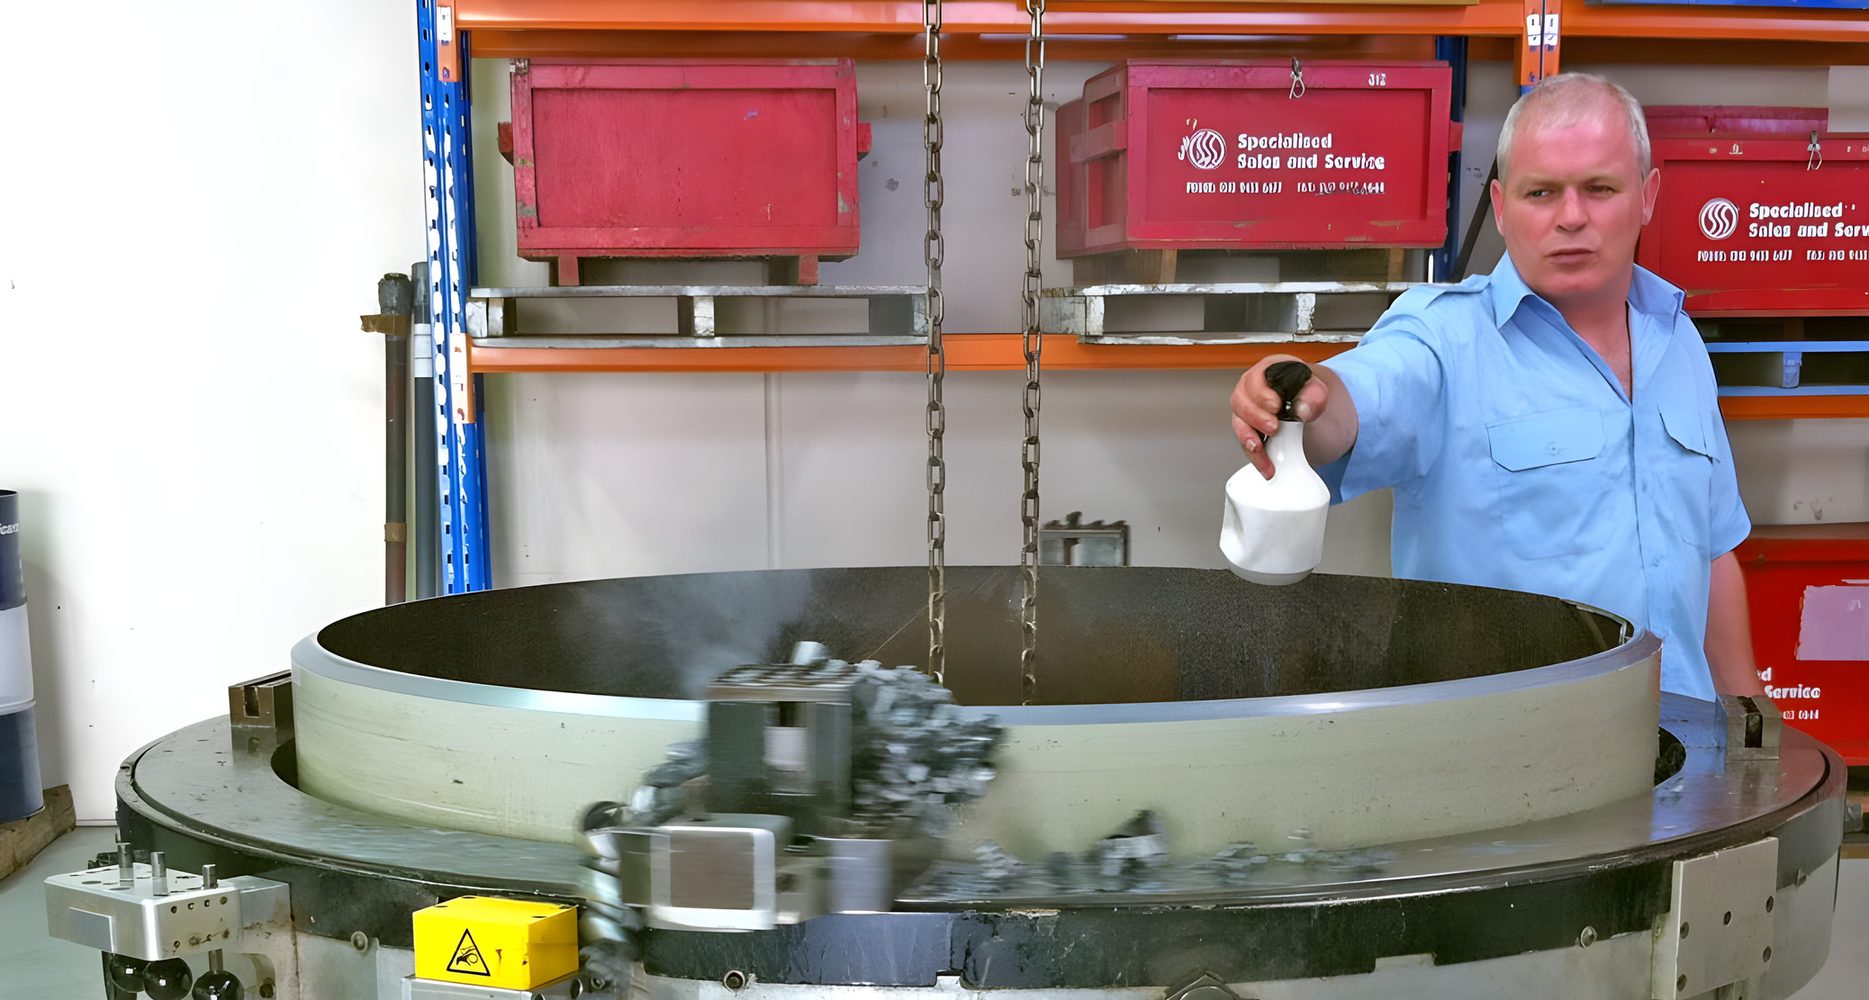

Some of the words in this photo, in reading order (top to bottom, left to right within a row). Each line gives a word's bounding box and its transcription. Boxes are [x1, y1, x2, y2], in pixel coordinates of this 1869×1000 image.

[1287, 154, 1317, 169] and
[1324, 153, 1385, 170] Service
[1797, 222, 1828, 237] and
